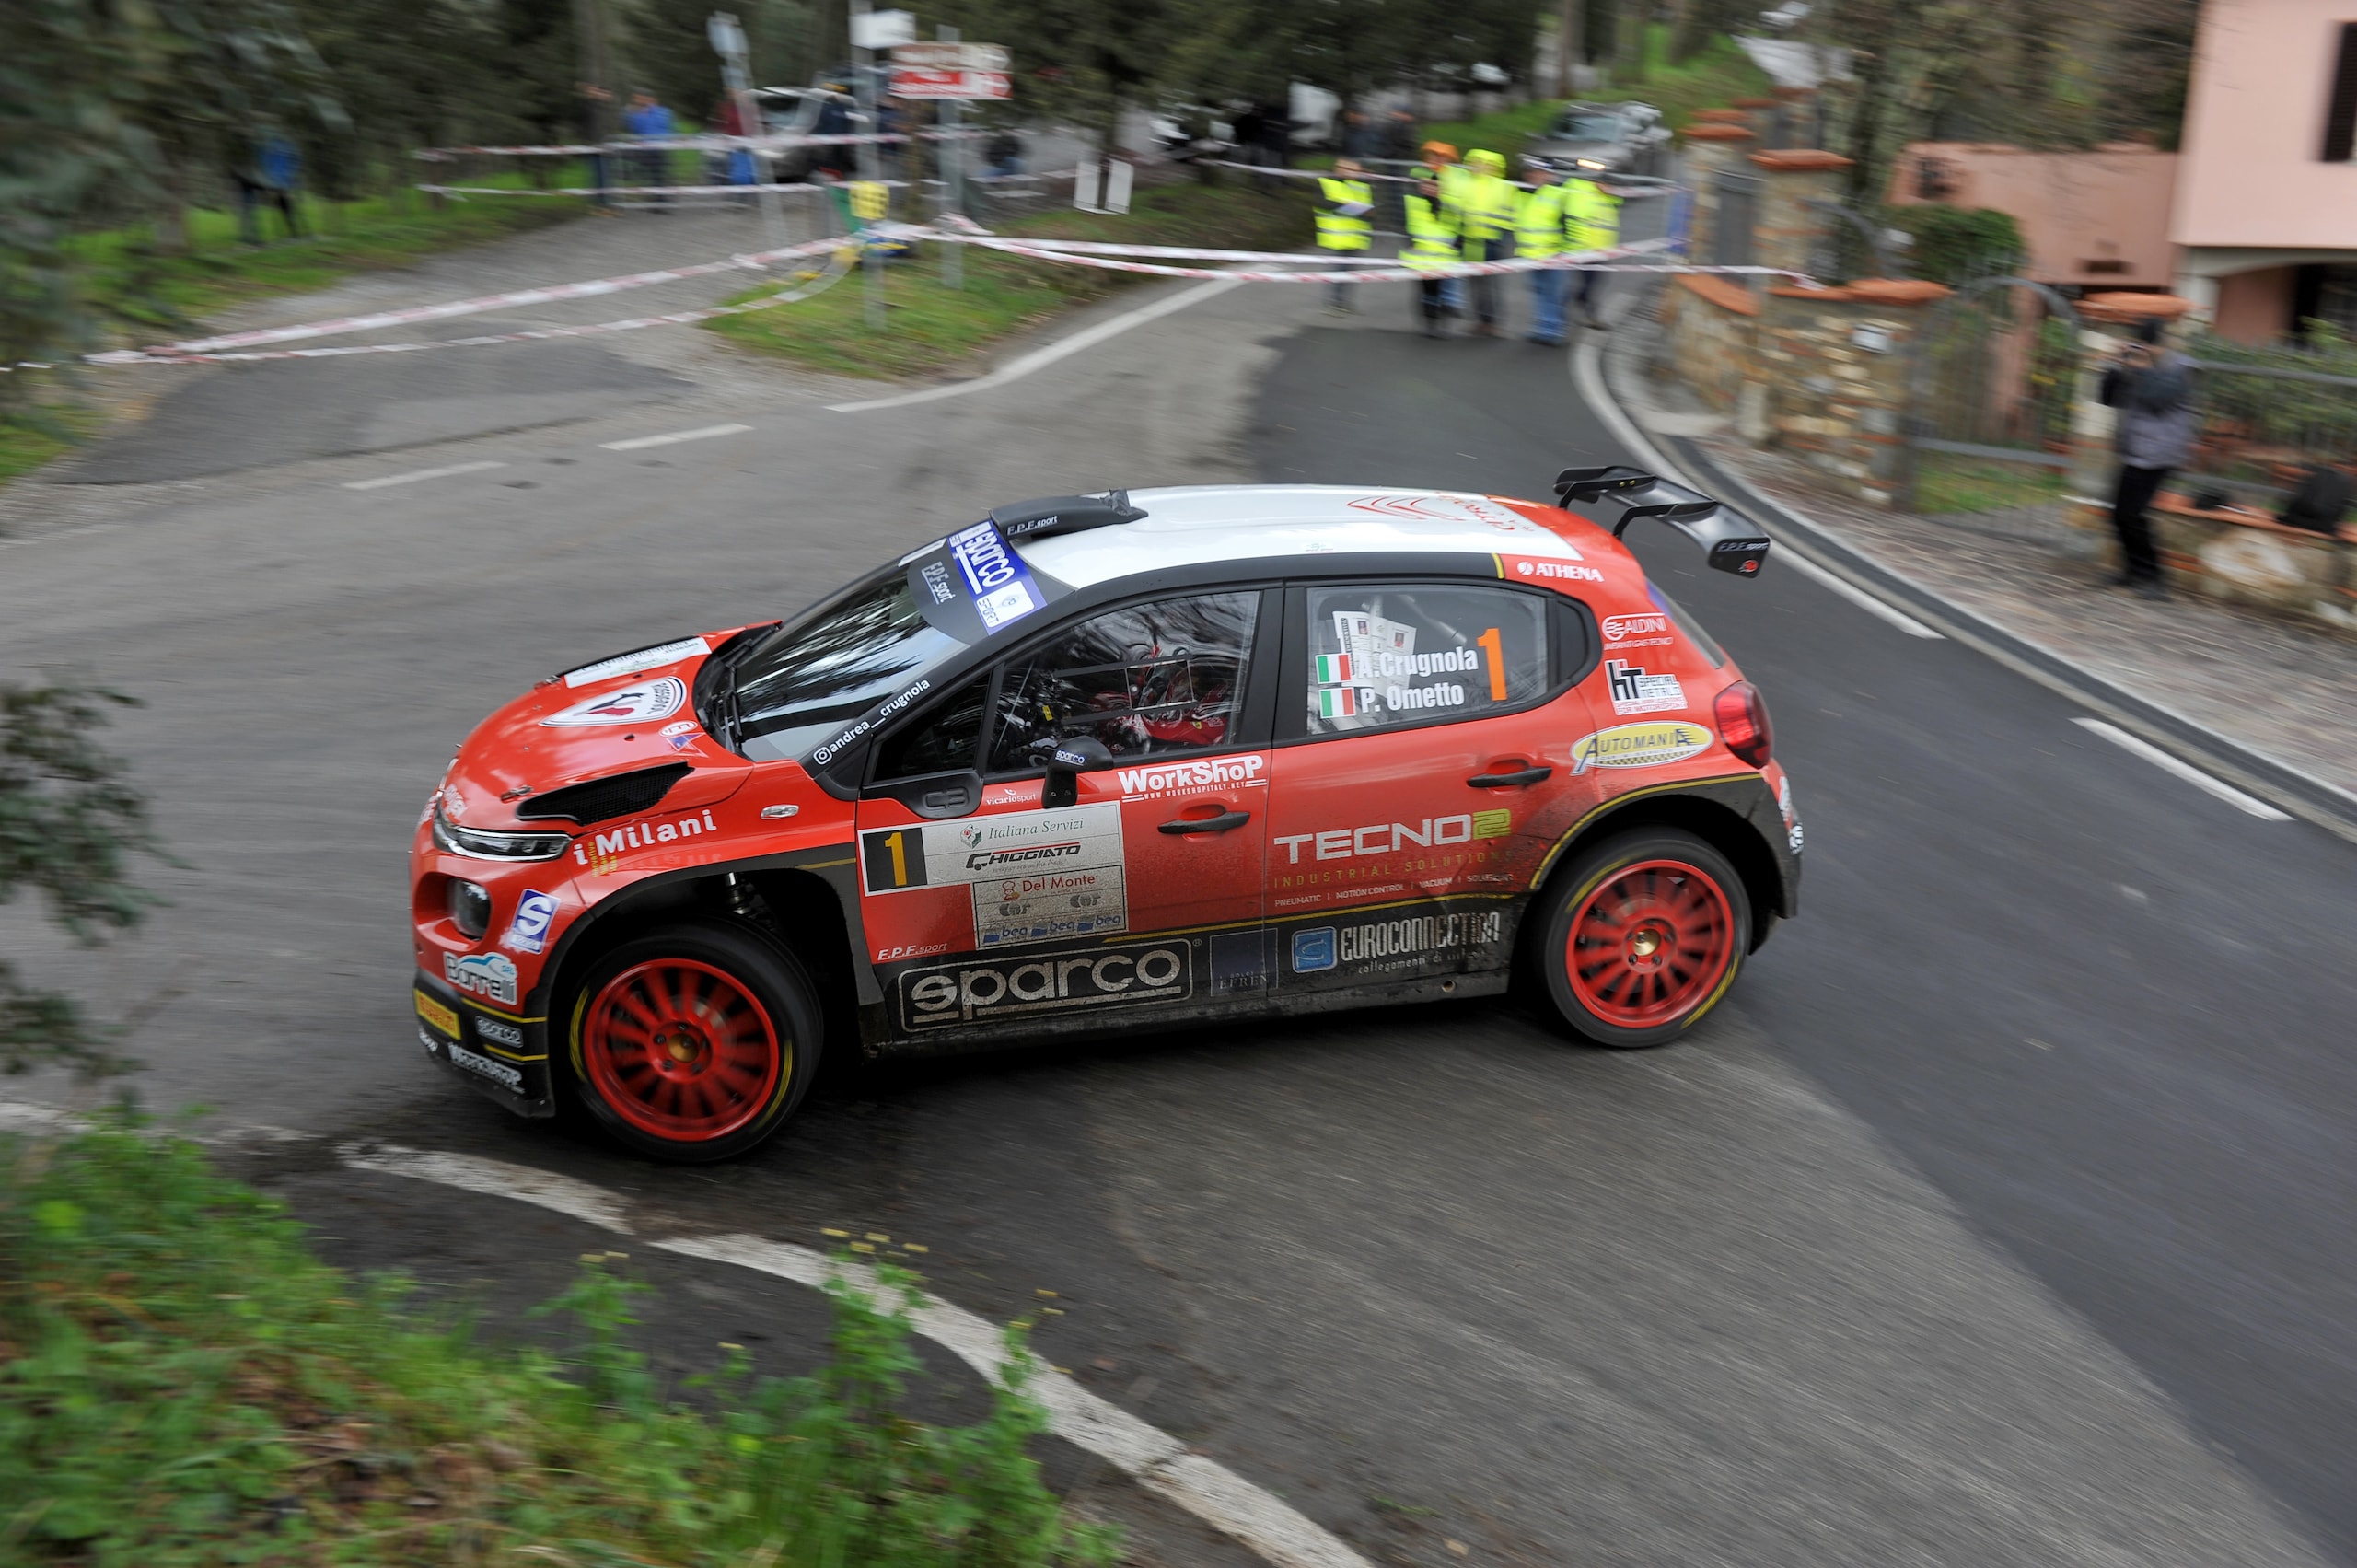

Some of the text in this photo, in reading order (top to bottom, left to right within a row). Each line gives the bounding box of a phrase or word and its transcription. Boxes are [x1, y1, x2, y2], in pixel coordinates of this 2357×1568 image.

[964, 530, 1015, 587] sparco
[1535, 563, 1604, 582] ATHENA
[1477, 628, 1507, 701] 1
[1360, 682, 1465, 714] P. Ometto
[1056, 750, 1085, 765] sparco
[1575, 728, 1695, 772] AUTOMANIA
[595, 809, 717, 856] Milani
[989, 818, 1085, 840] Italiana Servizi
[884, 832, 908, 887] 1
[1023, 878, 1045, 892] Del
[1051, 875, 1096, 889] Monte
[1274, 865, 1391, 889] INDUSTRIAL
[1274, 895, 1322, 906] PNEUMATIC
[444, 952, 517, 1005] Borrelli
[1358, 955, 1426, 975] collegamenti
[911, 949, 1181, 1020] sparco
